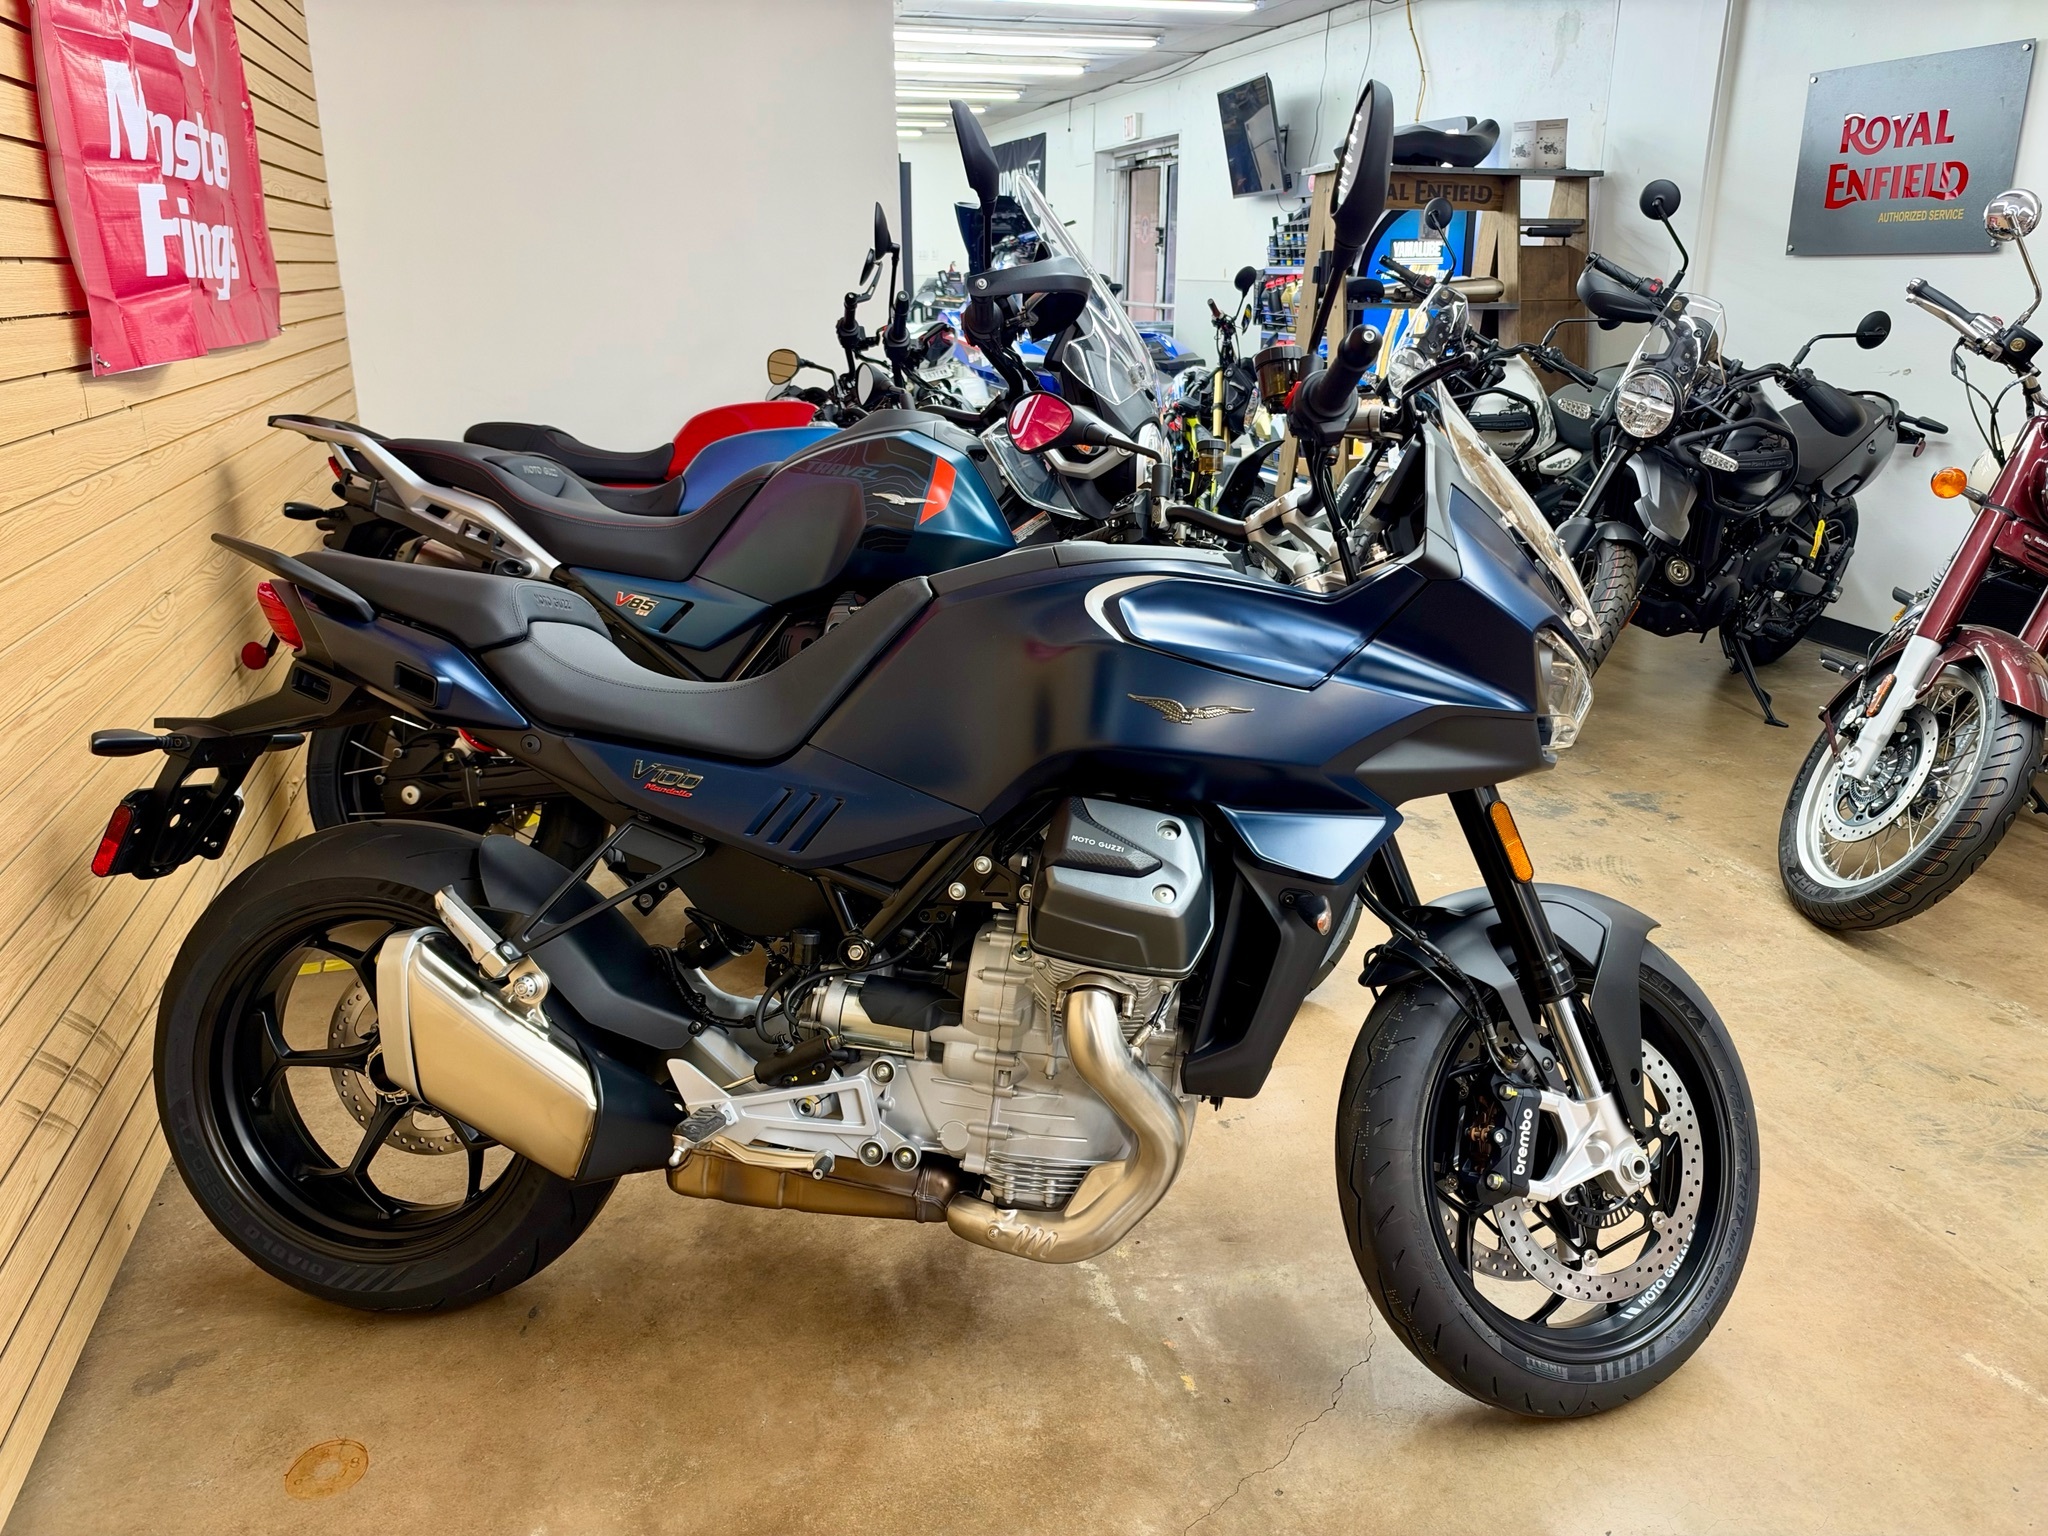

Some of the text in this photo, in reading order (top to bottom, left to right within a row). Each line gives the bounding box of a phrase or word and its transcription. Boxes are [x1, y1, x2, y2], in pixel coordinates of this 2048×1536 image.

[1840, 109, 1955, 155] ROYAL
[1824, 161, 1970, 210] ENFIELD
[1877, 208, 1965, 223] AUTHORIZED SERVICE
[1393, 241, 1443, 258] YAMALUBE
[522, 465, 542, 475] MOTO
[805, 460, 878, 480] TRAVEL
[615, 590, 660, 612] V85
[633, 759, 704, 790] V100
[643, 783, 693, 798] Mandello
[1071, 834, 1125, 853] MOTO GUZZI
[1512, 1108, 1533, 1176] brembo
[1637, 1278, 1667, 1308] MOTO
